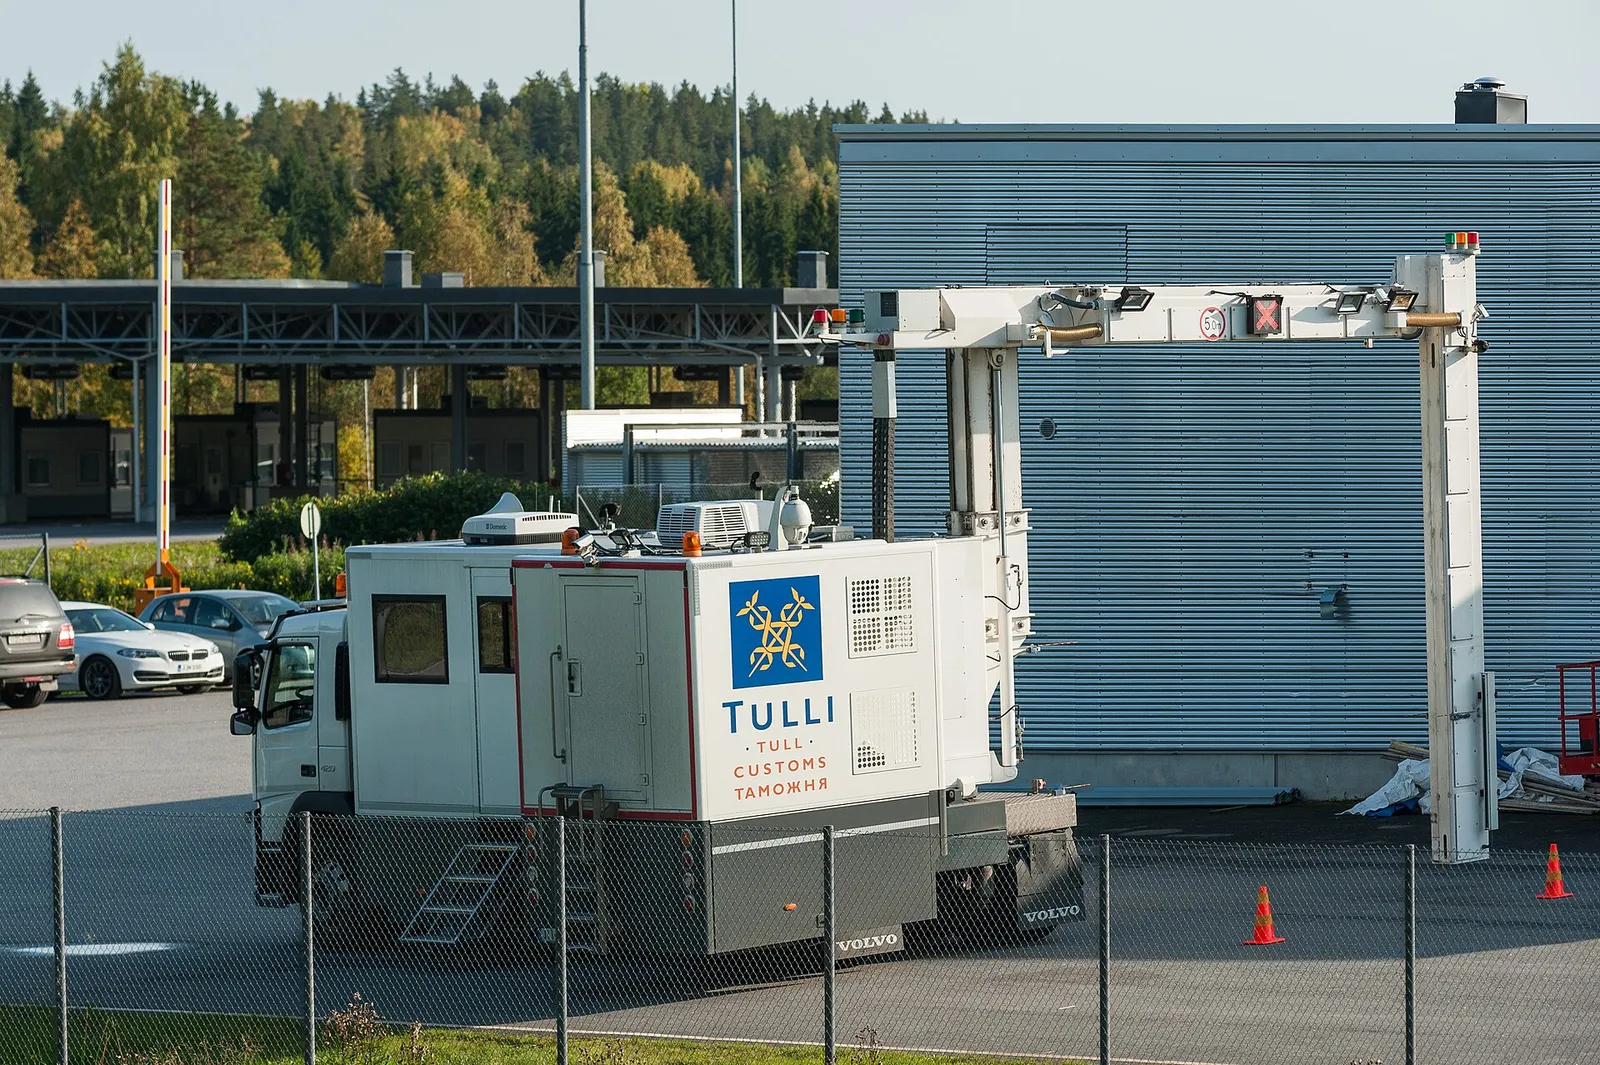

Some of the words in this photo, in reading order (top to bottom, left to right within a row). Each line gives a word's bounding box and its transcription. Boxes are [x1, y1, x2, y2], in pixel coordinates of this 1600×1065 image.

[722, 696, 834, 733] TULLI
[757, 737, 802, 753] TULL
[734, 756, 827, 778] CUSTOMS
[734, 777, 828, 800] ТАМОЖНЯ
[1023, 905, 1080, 923] VOLVO
[836, 933, 898, 951] VOLVO
